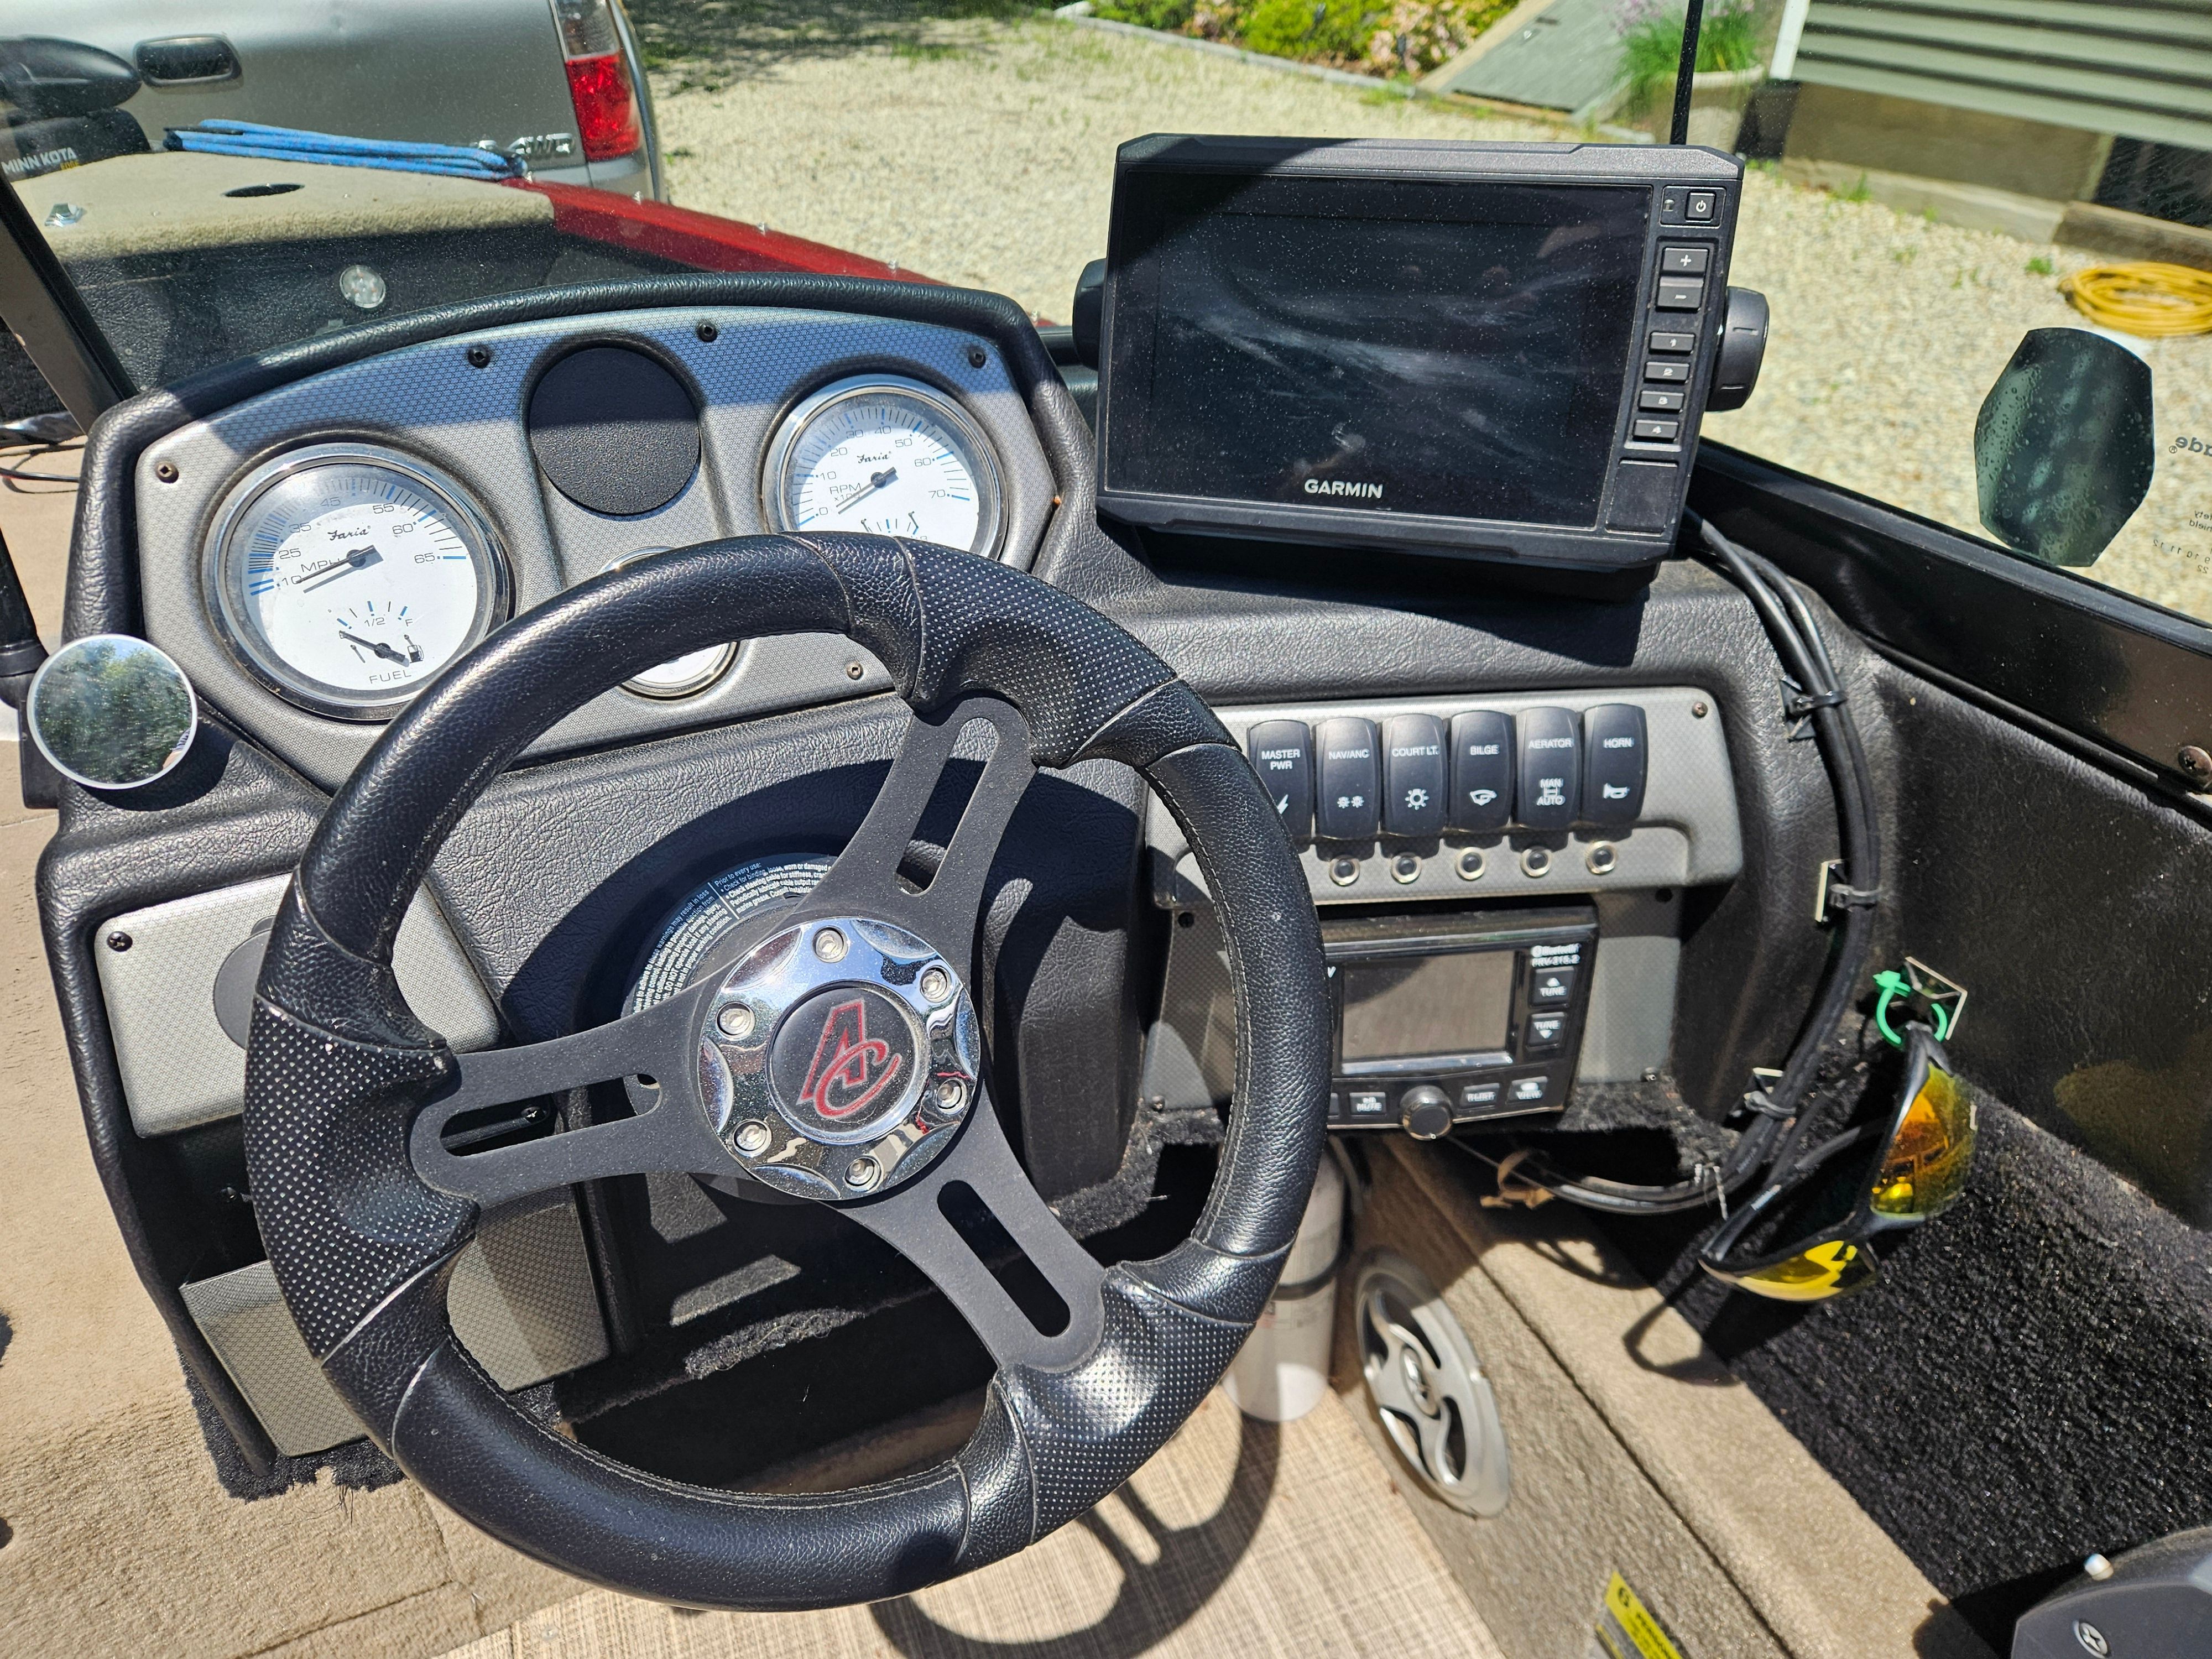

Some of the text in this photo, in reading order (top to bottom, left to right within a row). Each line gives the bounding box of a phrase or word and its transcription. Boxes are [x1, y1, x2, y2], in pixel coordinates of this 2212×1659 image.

[1, 147, 77, 175] MINN KOTA
[1670, 338, 1677, 347] 1
[1663, 367, 1673, 376] 2
[1658, 396, 1668, 405] 3
[846, 430, 864, 439] 30
[874, 426, 891, 434] 40
[1652, 425, 1661, 434] 4
[895, 438, 912, 447] 50
[831, 447, 847, 457] 20
[915, 458, 931, 467] 60
[820, 471, 837, 481] 10
[830, 483, 862, 494] RPM
[928, 489, 946, 498] 70
[1305, 479, 1383, 498] GARMIN
[320, 497, 341, 507] 45
[373, 503, 394, 514] 55
[289, 522, 312, 534] 35
[392, 523, 414, 534] 60
[279, 548, 301, 560] 25
[414, 552, 435, 564] 65
[300, 558, 342, 572] MPH
[281, 575, 302, 586] 10
[364, 617, 386, 627] 1/2
[405, 618, 413, 627] F
[369, 670, 411, 684] FUEL
[1528, 738, 1574, 749] AERATOR
[1604, 737, 1634, 748] HORN
[1261, 749, 1300, 759] MASTER
[1392, 746, 1425, 757] COURT
[1470, 744, 1499, 755] BILGE
[1270, 760, 1293, 770] PWR
[1540, 778, 1563, 788] MAN
[1536, 795, 1566, 806] AUTO
[714, 877, 728, 886] Prior
[734, 867, 749, 877] every
[724, 879, 740, 891] Check
[747, 870, 769, 880] binding,
[767, 865, 784, 874] loose,
[804, 863, 828, 872] damaged
[728, 885, 746, 898] Check
[744, 878, 768, 890] steering
[766, 873, 781, 881] cable
[789, 870, 813, 879] stiffness,
[730, 889, 759, 907] Periodically
[758, 880, 780, 893] lubricate
[794, 879, 811, 887] output
[736, 901, 753, 914] marine
[752, 894, 771, 906] grease.
[769, 886, 789, 898] Consult
[707, 908, 728, 926] steering
[699, 925, 709, 934] any
[639, 971, 650, 990] adhere
[648, 948, 660, 964] these
[657, 926, 674, 947] warnings
[671, 914, 683, 927] may
[681, 901, 694, 916] result
[697, 889, 709, 900] loss
[649, 967, 661, 988] control,
[655, 948, 671, 968] leading
[665, 940, 674, 948] to
[670, 921, 688, 943] possible
[686, 906, 704, 924] ejection
[702, 896, 714, 909] from
[685, 935, 698, 949] boat
[685, 950, 698, 969] proper
[695, 933, 713, 953] working
[709, 916, 732, 935] condition.
[656, 969, 668, 993] collision
[664, 951, 679, 971] causing
[675, 931, 692, 953] property
[688, 915, 708, 933] damage,
[704, 902, 721, 916] injury,
[675, 948, 690, 969] operate
[669, 967, 679, 980] NOT
[665, 979, 674, 991] DO
[1540, 986, 1566, 997] TUNE
[1533, 1020, 1561, 1030] TUNE
[1516, 1090, 1542, 1099] VIEW
[1357, 1103, 1382, 1112] MUTE
